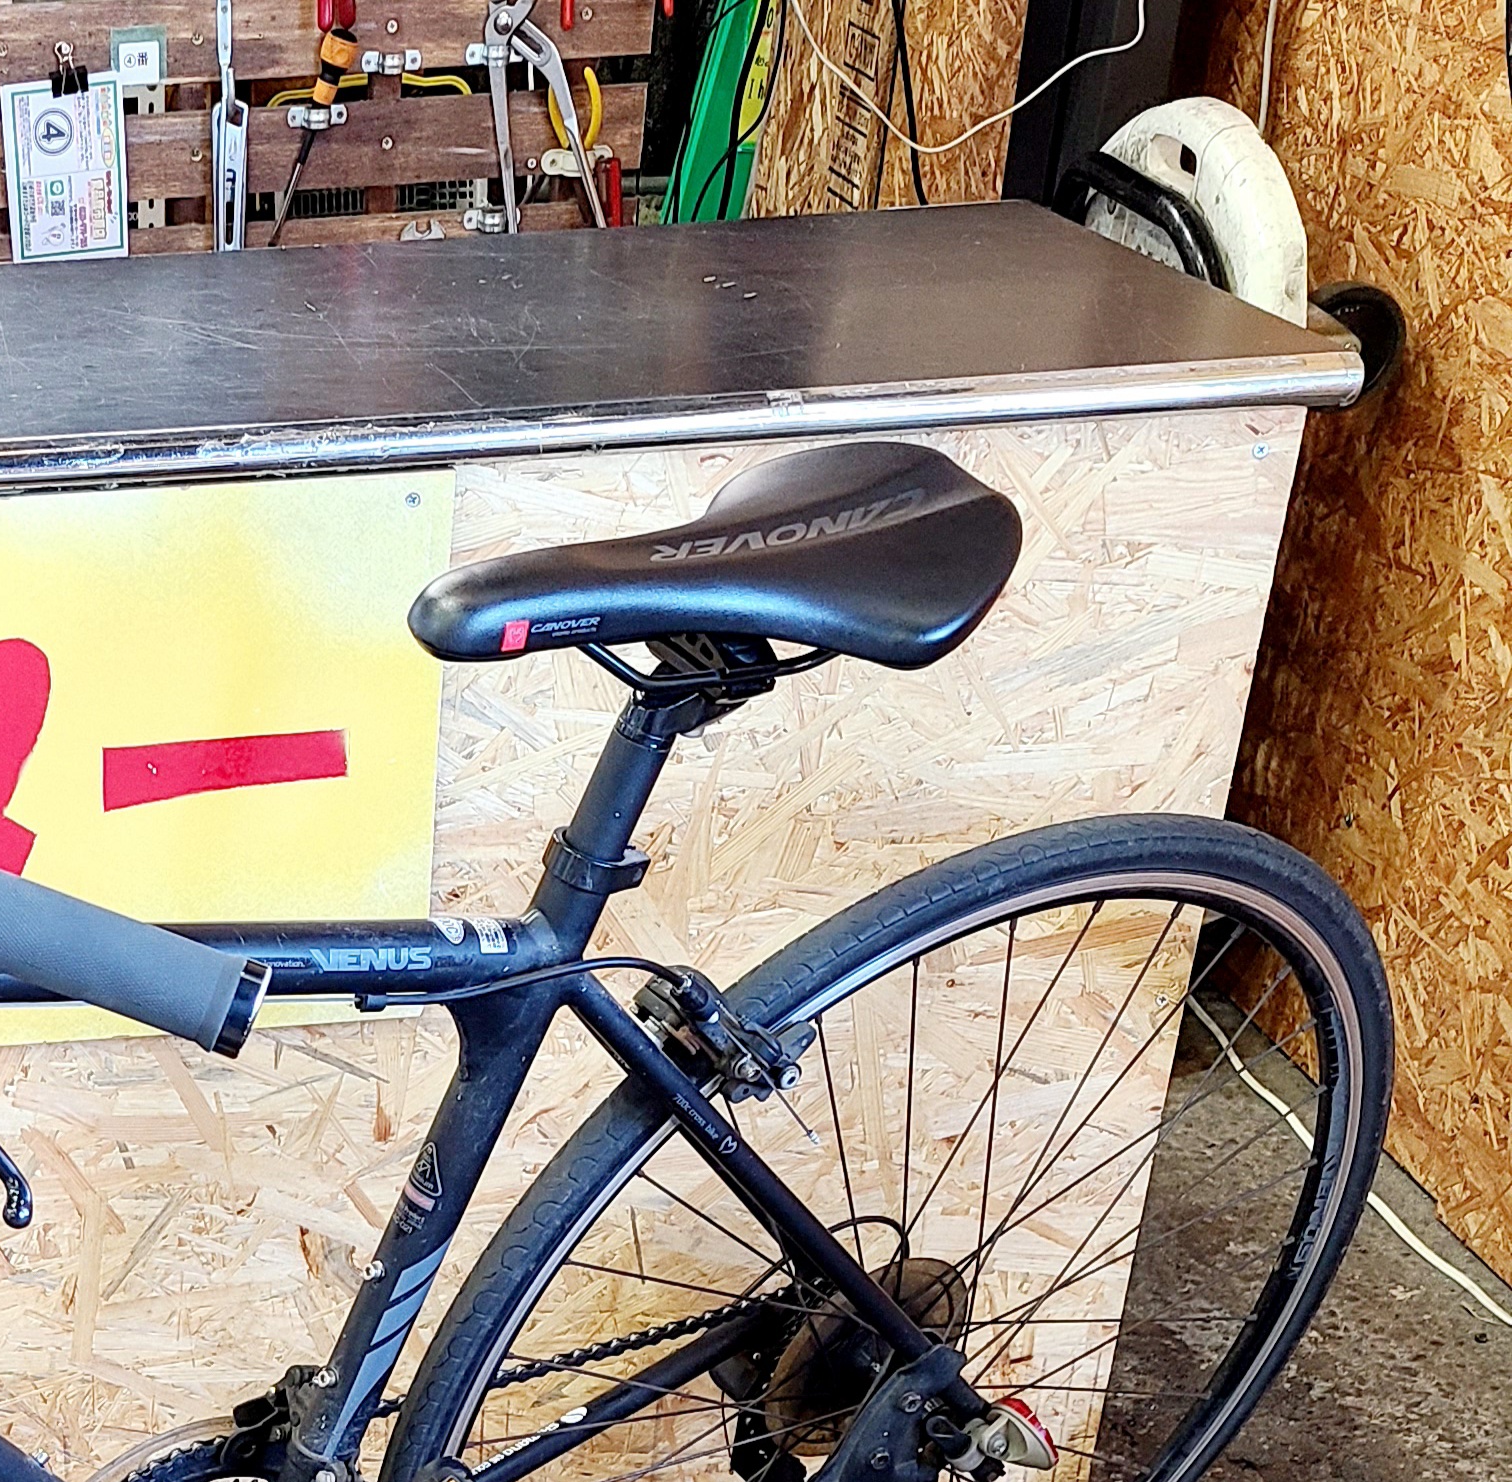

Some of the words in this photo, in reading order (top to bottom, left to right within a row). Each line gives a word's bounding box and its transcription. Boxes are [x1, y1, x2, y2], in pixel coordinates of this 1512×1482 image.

[650, 487, 926, 562] CANOVER
[531, 616, 601, 634] CANOVER
[309, 946, 433, 974] VENUS
